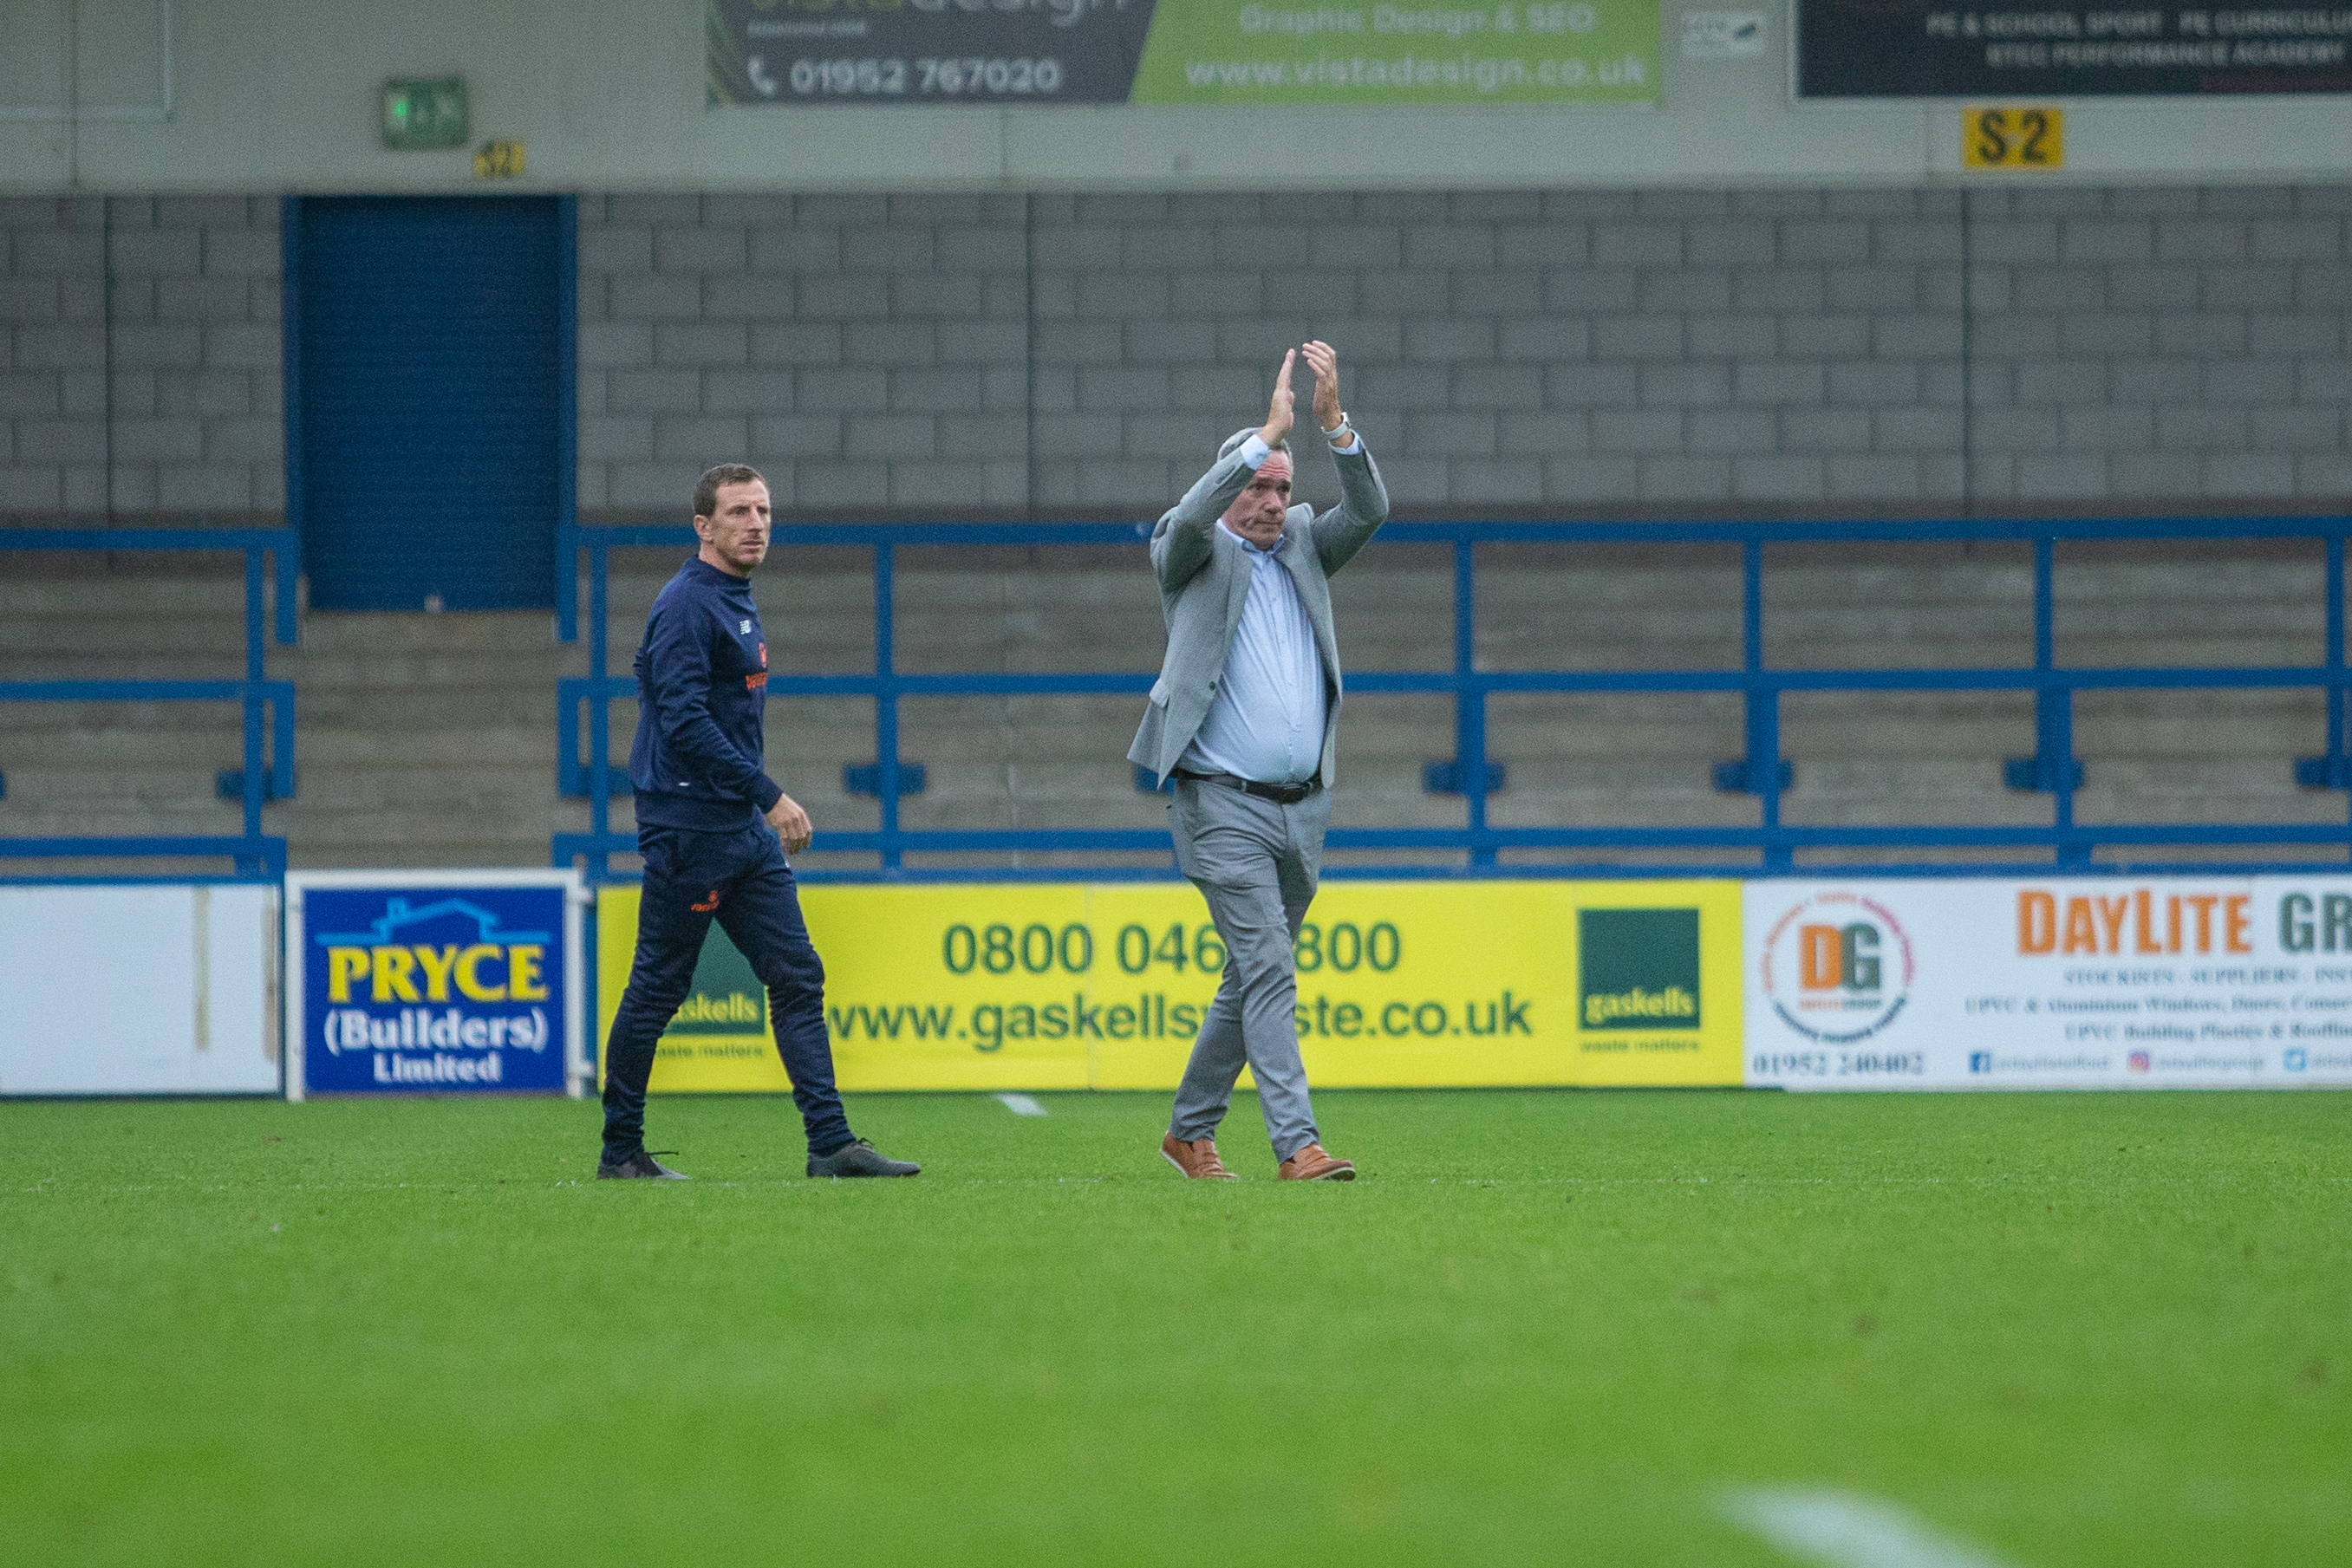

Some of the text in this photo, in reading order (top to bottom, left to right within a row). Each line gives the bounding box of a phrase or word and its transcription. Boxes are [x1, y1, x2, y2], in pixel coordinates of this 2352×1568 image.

[1240, 4, 1597, 36] Graphic Design & SEO
[790, 56, 1065, 95] 01952 767020
[1184, 50, 1647, 93] www.vistadesign.co.uk
[942, 921, 1402, 975] 0800 046 800
[1798, 922, 1881, 991] DG
[327, 943, 550, 1004] PRYCE
[1586, 986, 1696, 1024] gaskells
[323, 1007, 550, 1057] (Builders)
[374, 1051, 503, 1085] Limited
[1752, 1052, 1828, 1075] 01952
